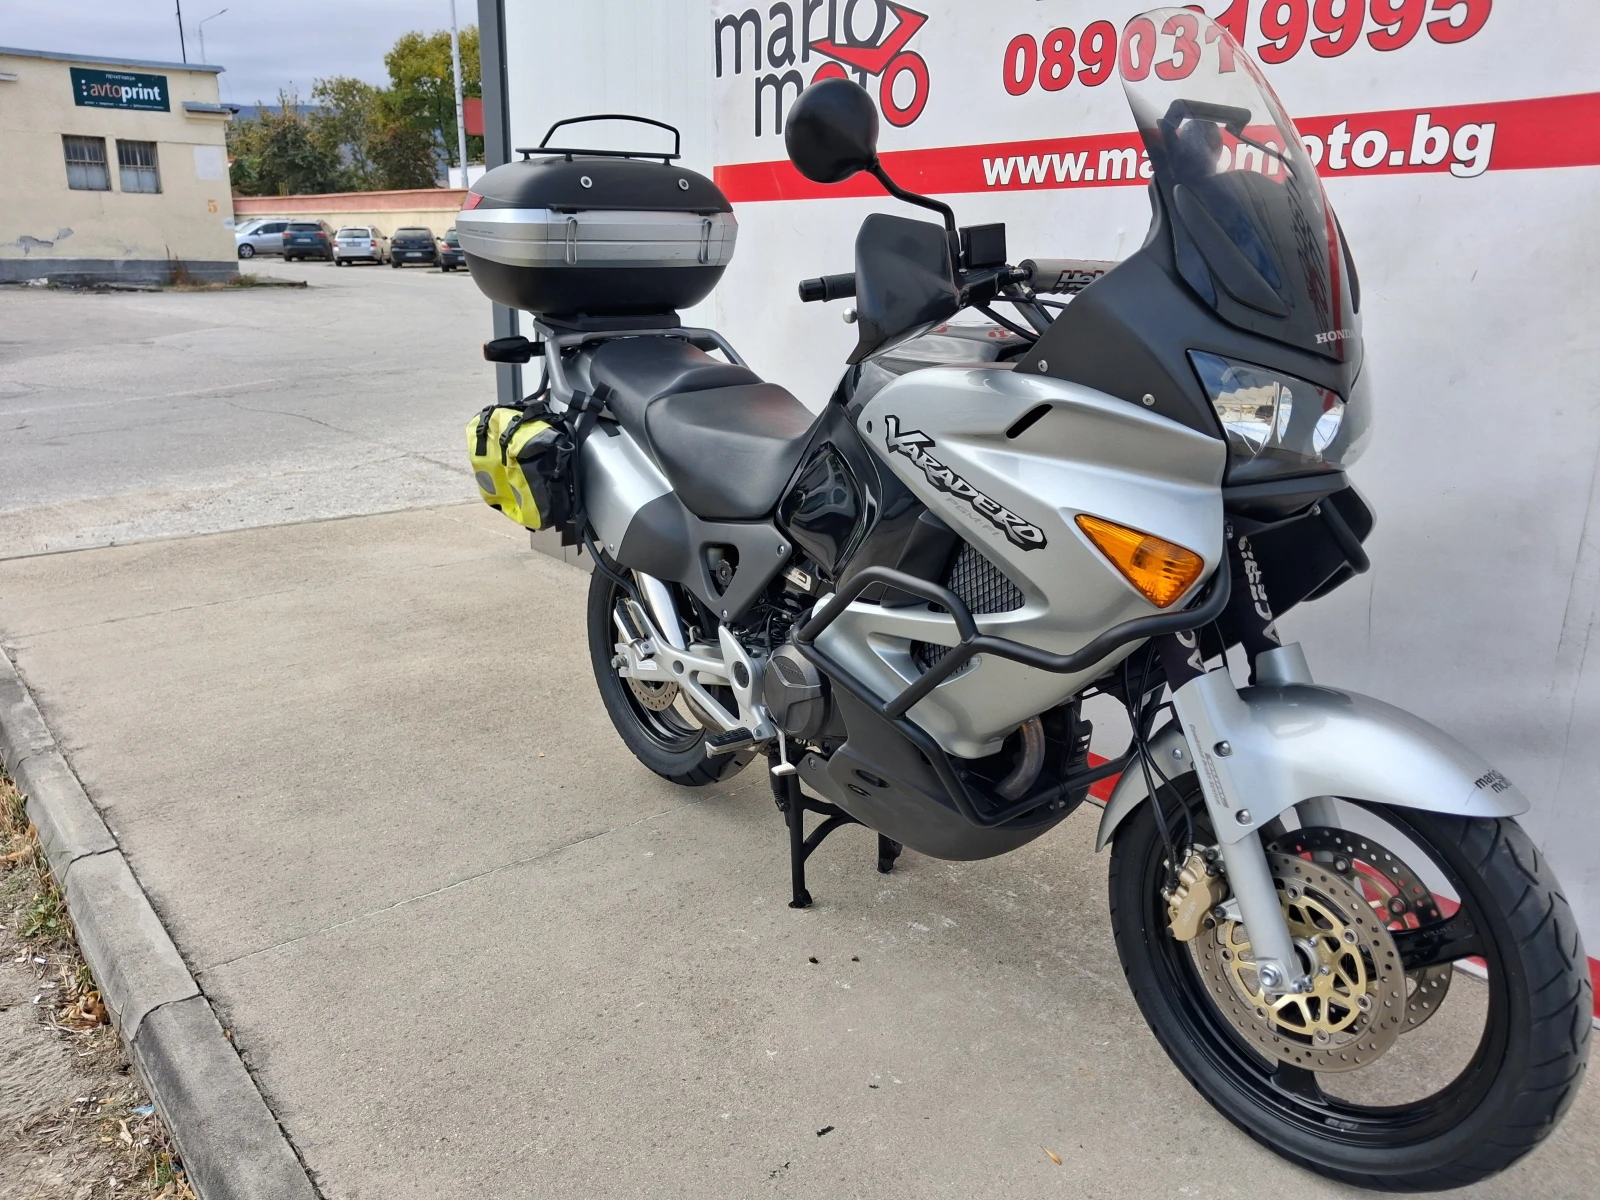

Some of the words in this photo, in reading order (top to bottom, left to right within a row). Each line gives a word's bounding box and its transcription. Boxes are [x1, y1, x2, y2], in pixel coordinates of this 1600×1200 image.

[90, 82, 161, 103] avtoprint
[207, 199, 218, 214] 5
[1315, 329, 1355, 344] HONDA
[885, 414, 1048, 552] VARADERO
